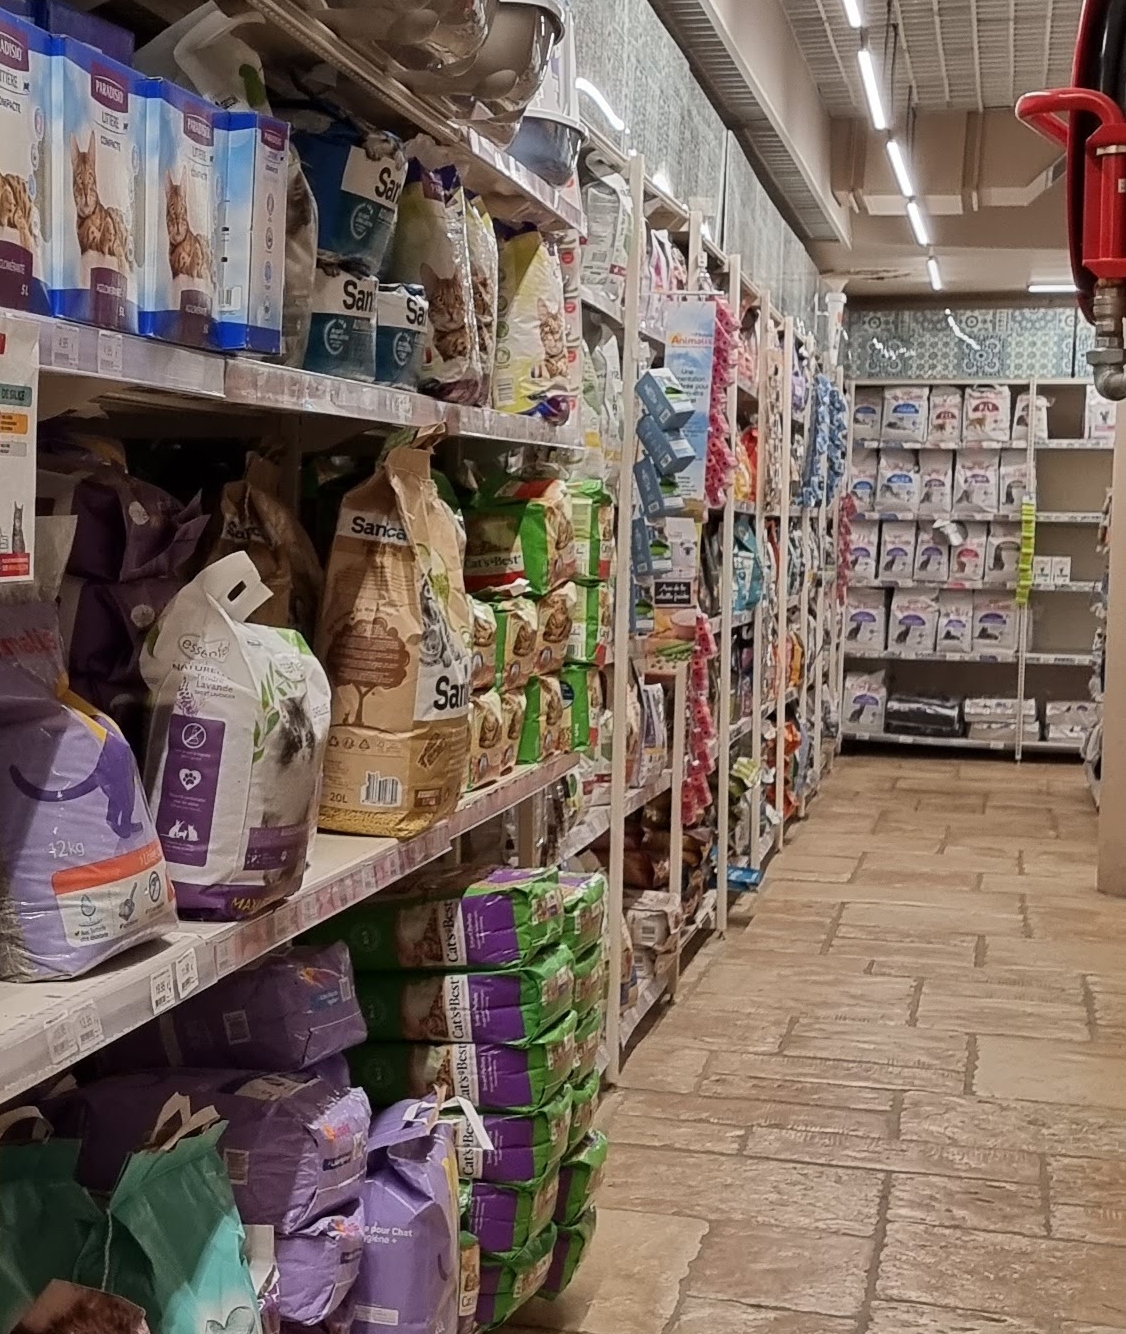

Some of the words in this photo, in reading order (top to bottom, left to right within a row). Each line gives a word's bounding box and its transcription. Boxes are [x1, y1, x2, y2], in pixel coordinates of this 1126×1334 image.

[95, 79, 124, 105] PARADISIO
[187, 118, 212, 140] PARADISIO
[671, 335, 712, 345] Animalis
[493, 554, 521, 566] Best
[196, 681, 234, 693] Lavande
[444, 900, 455, 929] Best
[448, 930, 460, 963] Cat's
[449, 977, 461, 1006] Best
[452, 1005, 464, 1039] Cat's
[457, 1043, 468, 1071] Best
[462, 1146, 475, 1176] Cat's
[372, 1223, 391, 1236] pour
[392, 1226, 413, 1238] Chat
